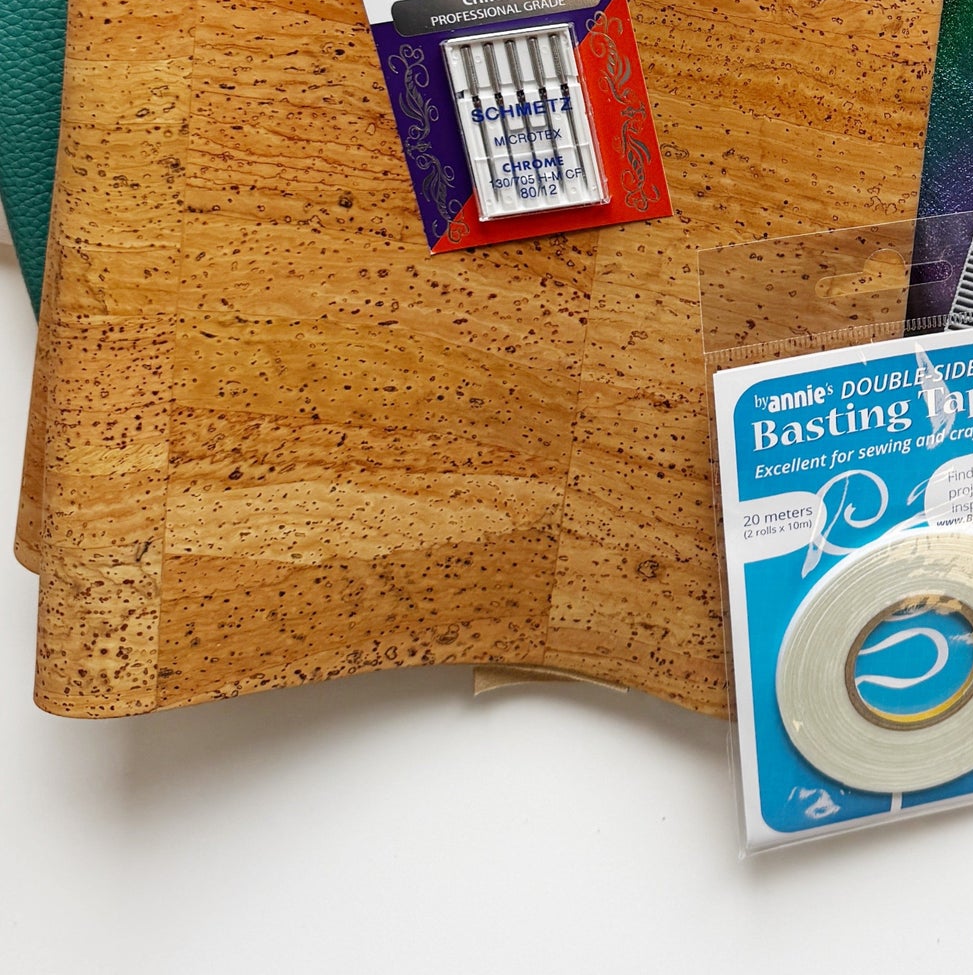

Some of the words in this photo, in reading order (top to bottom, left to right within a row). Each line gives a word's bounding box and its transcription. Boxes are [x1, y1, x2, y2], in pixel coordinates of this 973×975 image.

[430, 4, 522, 27] PROFESSIONAL
[471, 96, 573, 123] SCHMETZ
[494, 128, 562, 147] MICROTEX
[502, 155, 565, 173] CHROME
[490, 174, 535, 189] 130/705
[521, 184, 557, 199] 80/12
[751, 400, 913, 452] Basting
[754, 456, 827, 479] Excellent
[828, 449, 854, 470] for
[858, 436, 912, 459] sewing
[915, 431, 947, 447] and
[948, 467, 973, 482] Find
[743, 514, 760, 528] 20
[764, 506, 813, 523] meters
[743, 529, 753, 540] (2
[756, 525, 777, 537] rolls
[788, 520, 812, 531] 10m)
